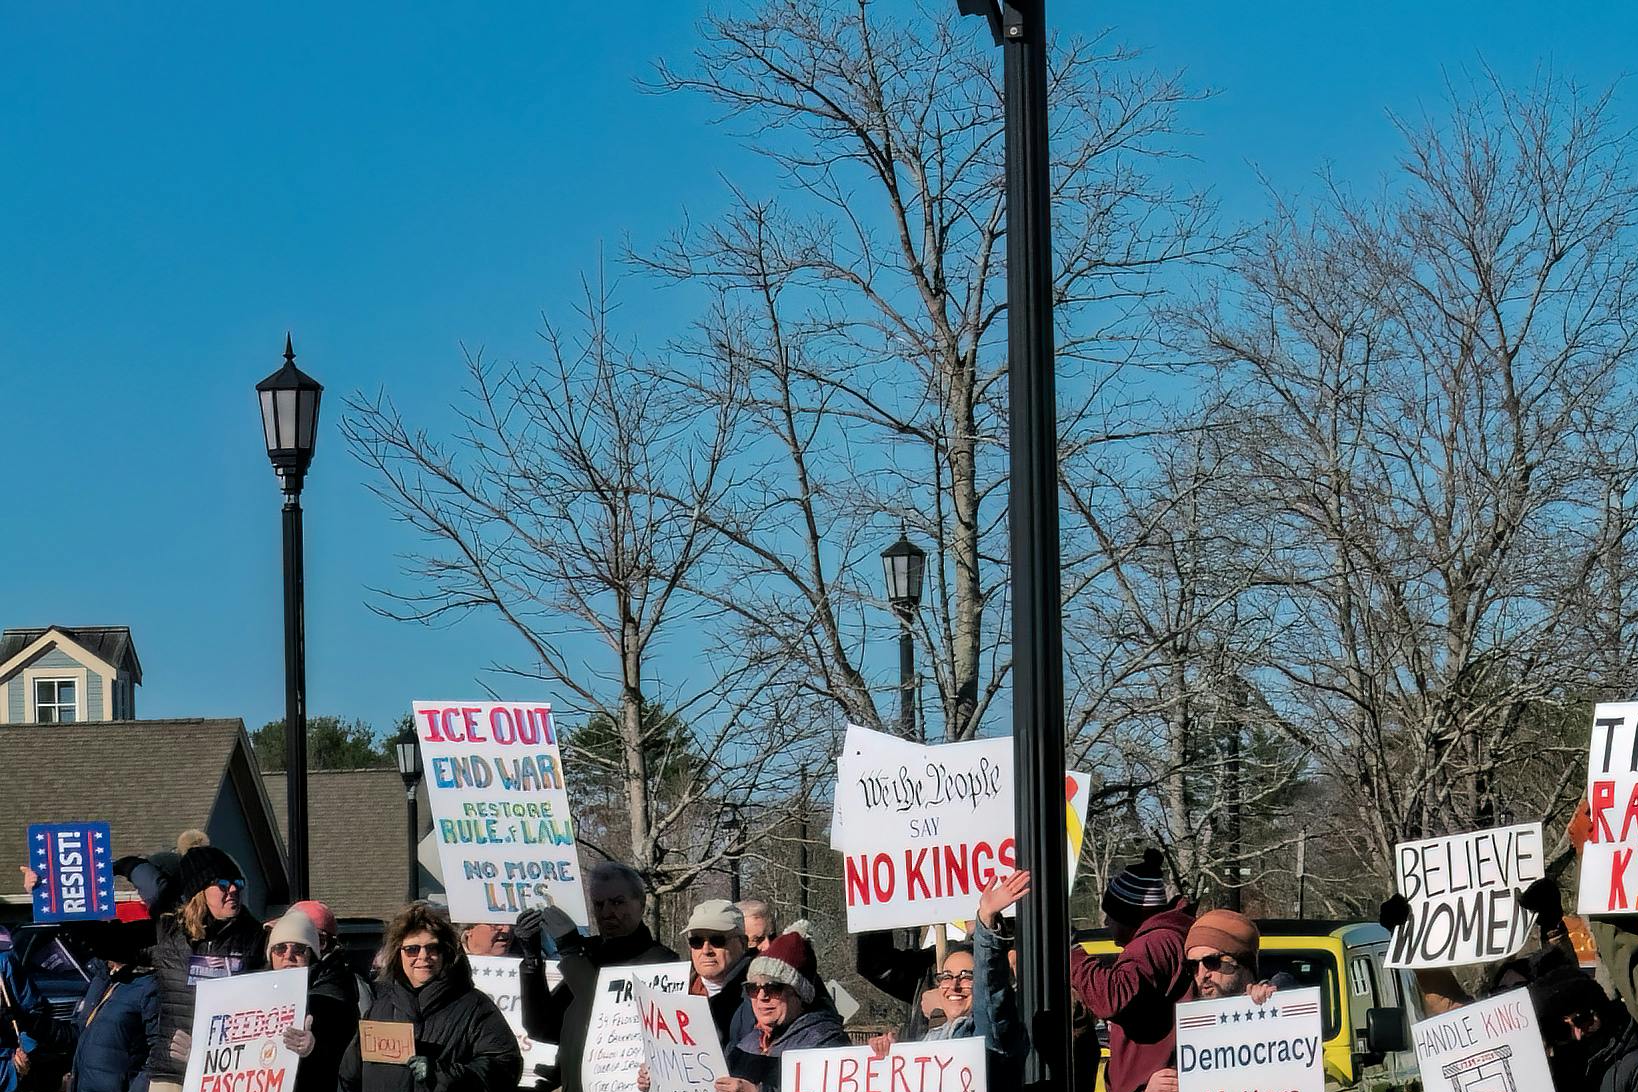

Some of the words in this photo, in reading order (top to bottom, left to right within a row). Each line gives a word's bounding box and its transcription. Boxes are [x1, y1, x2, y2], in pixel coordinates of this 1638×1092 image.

[418, 707, 487, 742] ICE
[489, 706, 556, 745] OUT
[432, 755, 493, 789] END
[494, 754, 563, 791] WAR
[857, 769, 890, 811] We
[893, 765, 923, 813] the
[925, 757, 1002, 814] People
[463, 801, 553, 818] RESTORE
[910, 817, 940, 838] SAY
[440, 818, 503, 844] RULE
[520, 817, 576, 845] LAW
[58, 831, 87, 913] RESIST!
[463, 860, 499, 880] NO
[504, 860, 575, 881] MORE
[847, 852, 895, 906] NO
[905, 838, 1016, 901] KINGS
[1401, 831, 1537, 901] BELIEVE
[484, 881, 554, 913] LIES
[1392, 887, 1534, 965] WOMEN
[208, 1003, 296, 1046] FREEDOM
[638, 996, 697, 1046] WAR
[1417, 1016, 1478, 1060] HANDLE
[1480, 1001, 1530, 1039] KINGS
[203, 1044, 246, 1074] NOT
[1180, 1036, 1319, 1073] Democracy
